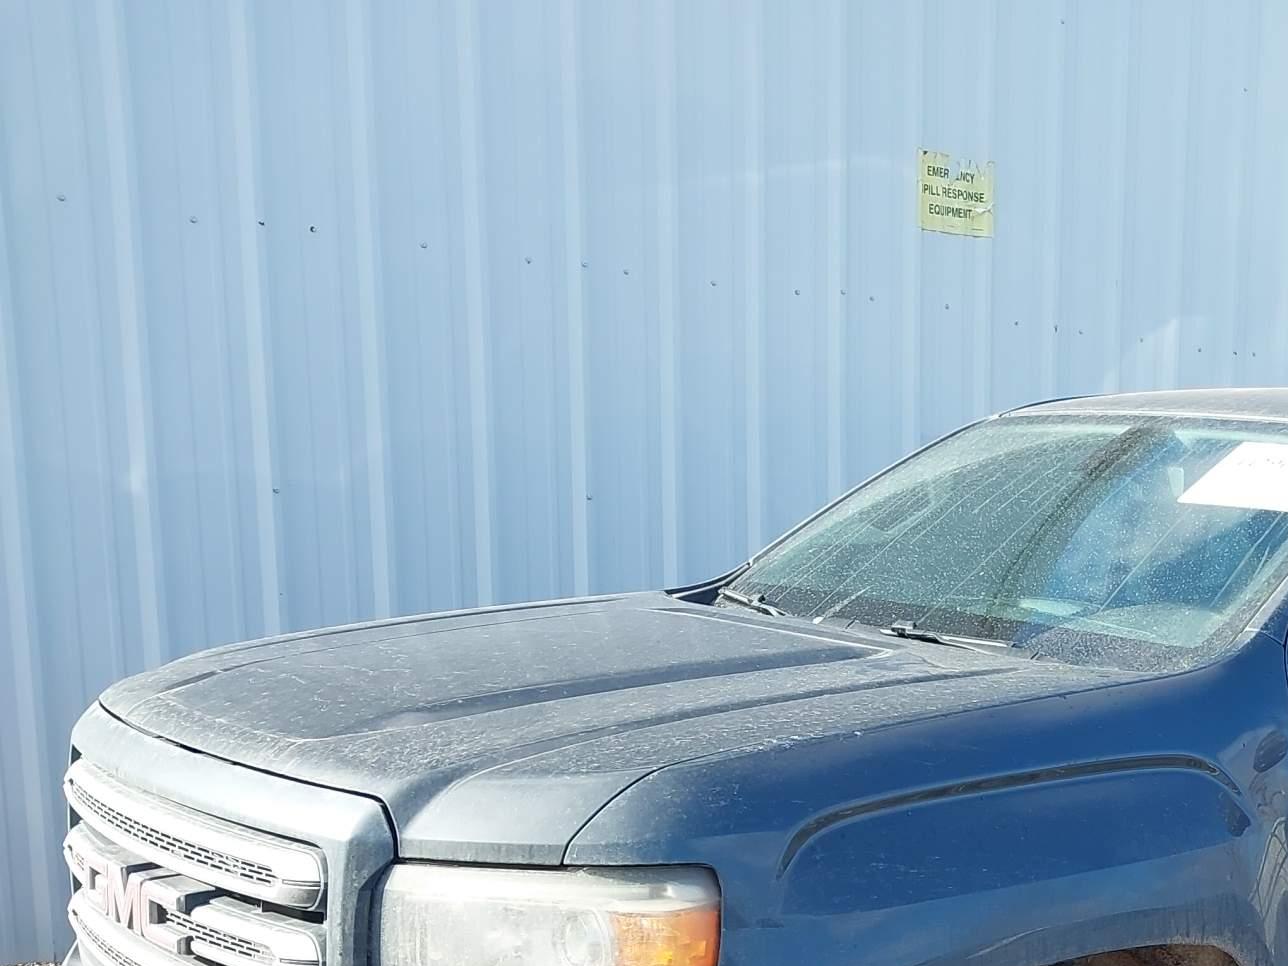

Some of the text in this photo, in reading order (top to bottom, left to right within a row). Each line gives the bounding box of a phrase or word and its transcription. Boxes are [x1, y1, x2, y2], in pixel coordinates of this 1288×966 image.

[927, 165, 975, 184] EMERNCY
[922, 183, 985, 203] PILL RESPONSE
[80, 856, 182, 956] GMC
